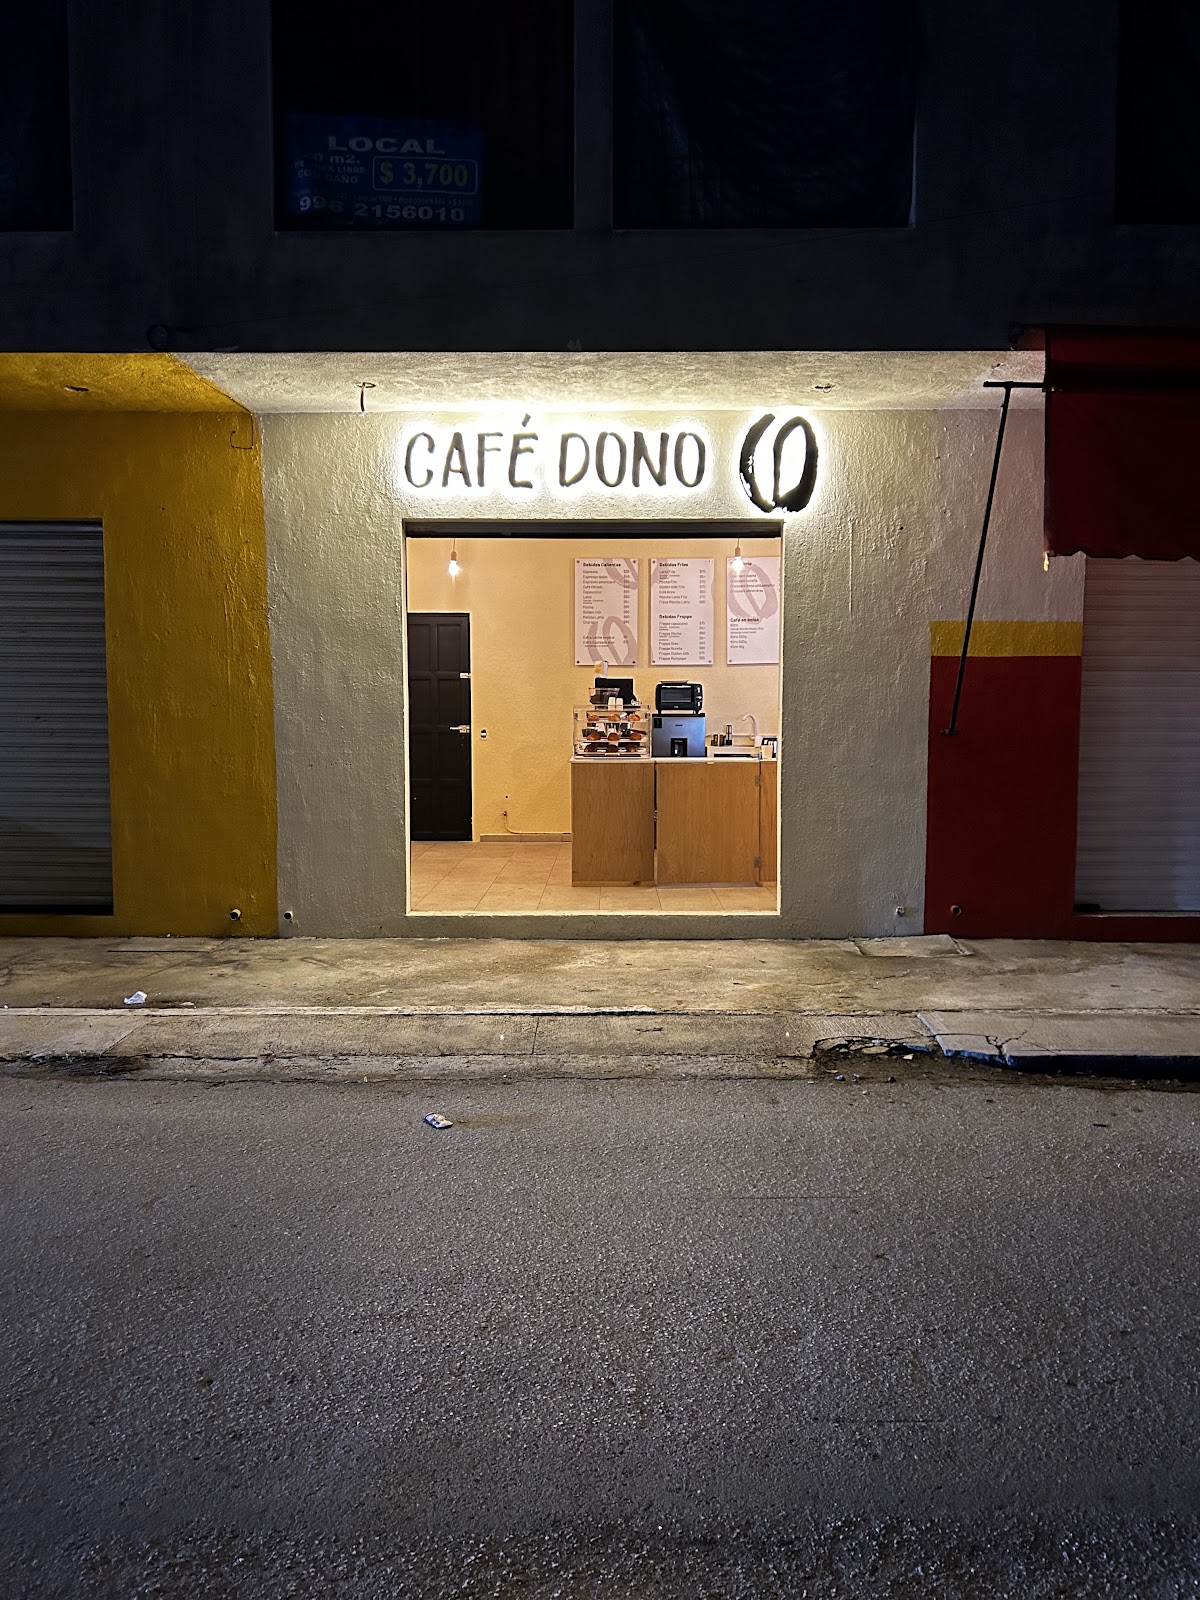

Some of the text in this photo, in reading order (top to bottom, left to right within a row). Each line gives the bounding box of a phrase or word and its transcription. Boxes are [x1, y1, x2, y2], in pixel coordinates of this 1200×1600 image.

[328, 136, 445, 155] LOCAL
[402, 161, 469, 188] 3,700
[353, 202, 465, 223] 2156010
[404, 413, 706, 489] CAFÉ DONO
